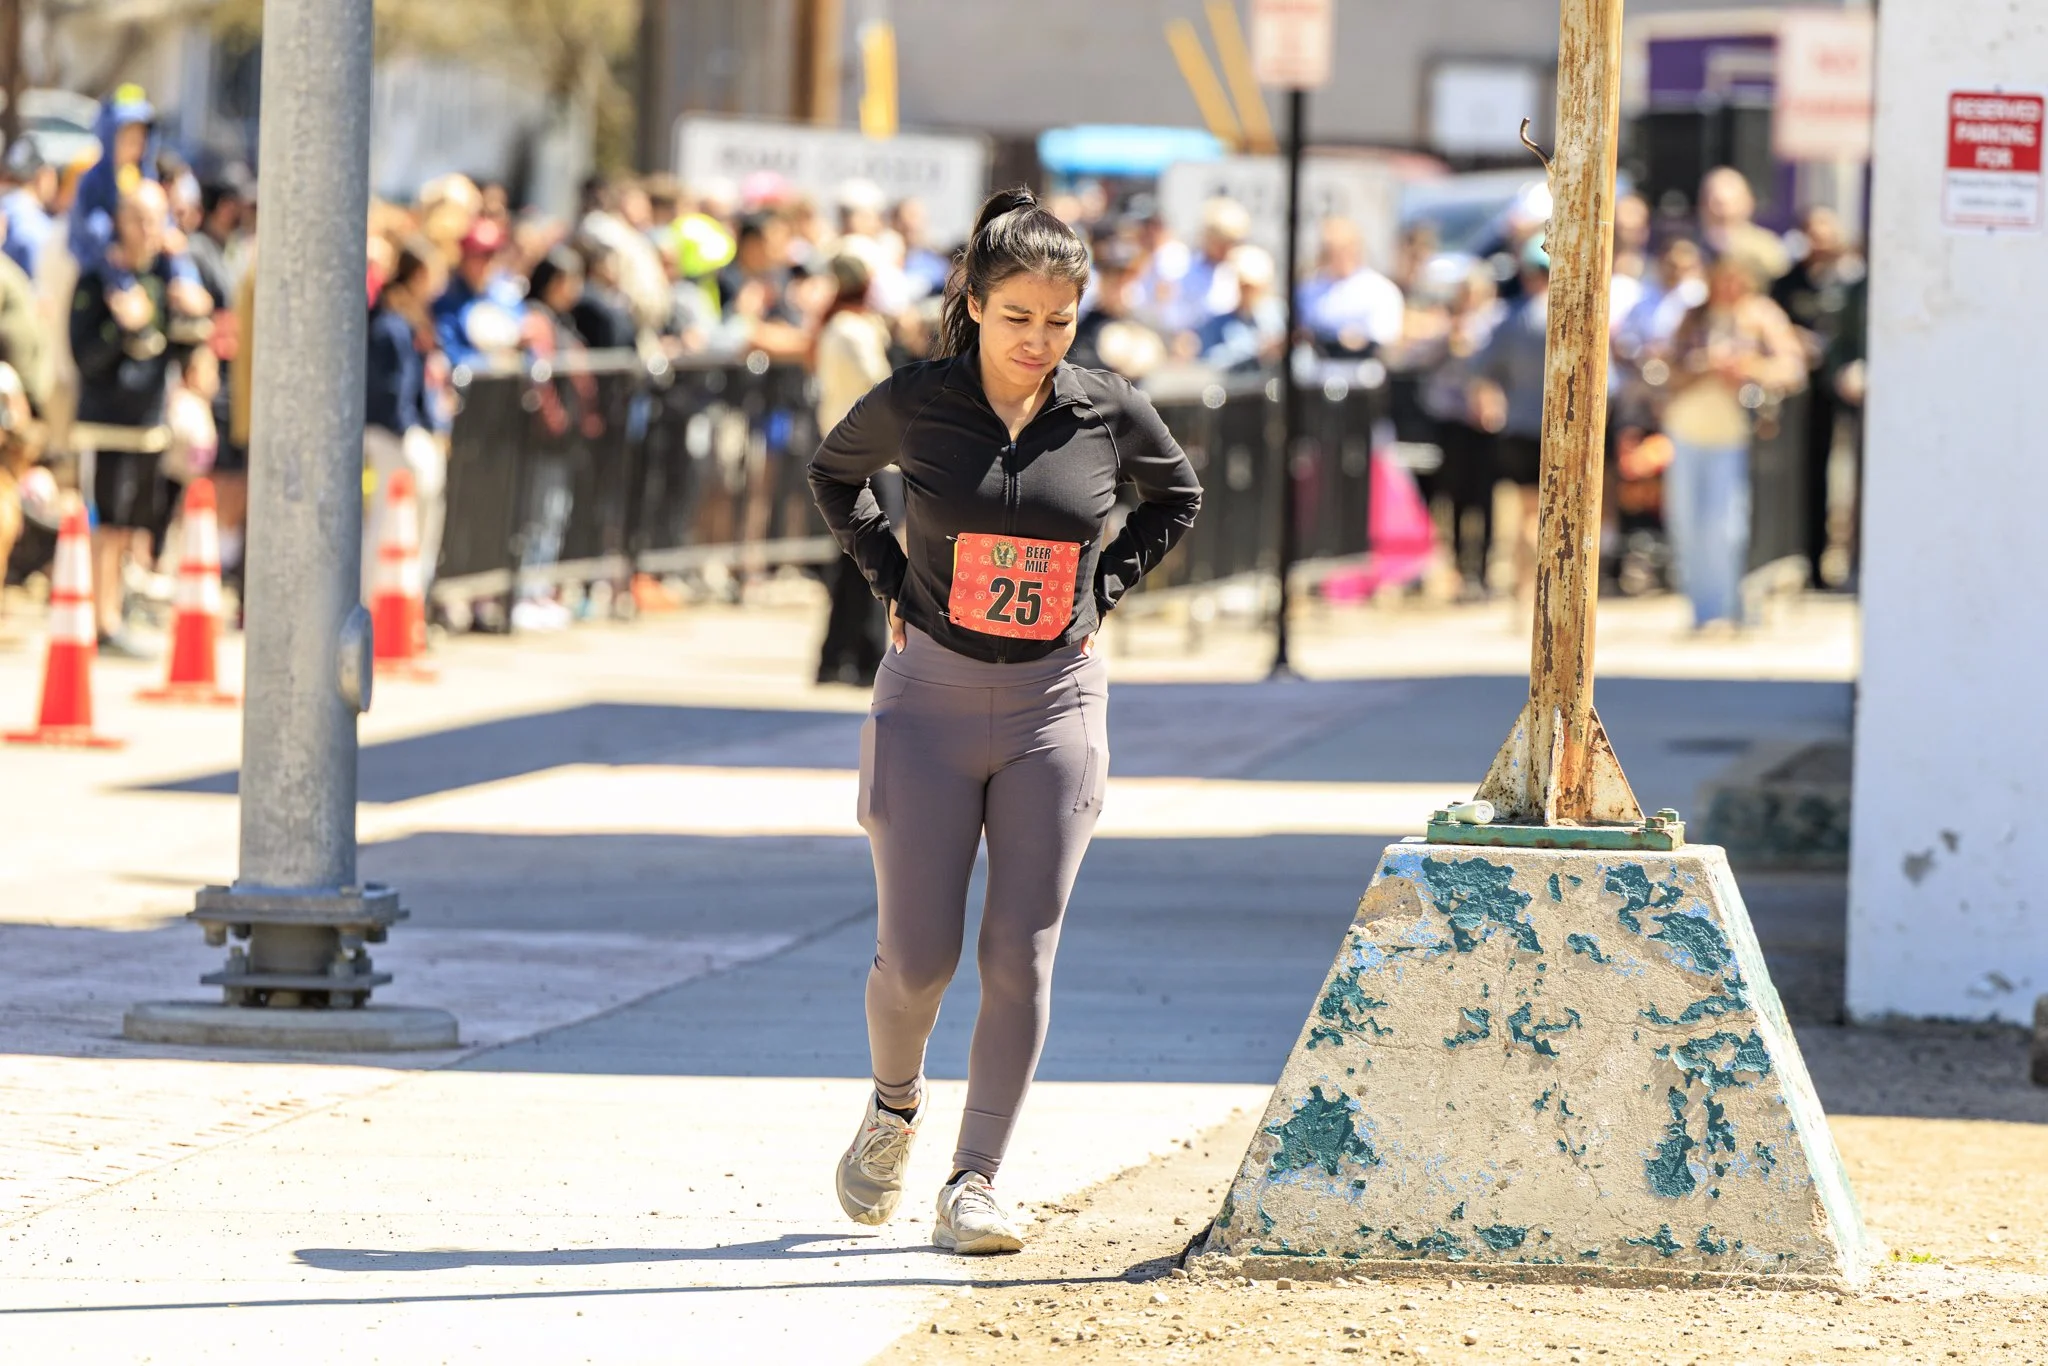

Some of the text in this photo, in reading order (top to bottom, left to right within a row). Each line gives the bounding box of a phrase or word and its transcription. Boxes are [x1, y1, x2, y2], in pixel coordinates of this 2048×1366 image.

[1955, 121, 2036, 146] PARKING
[1975, 146, 2013, 169] FOR
[1026, 546, 1051, 559] BEER
[1025, 560, 1048, 572] MILE
[985, 576, 1043, 626] 25
